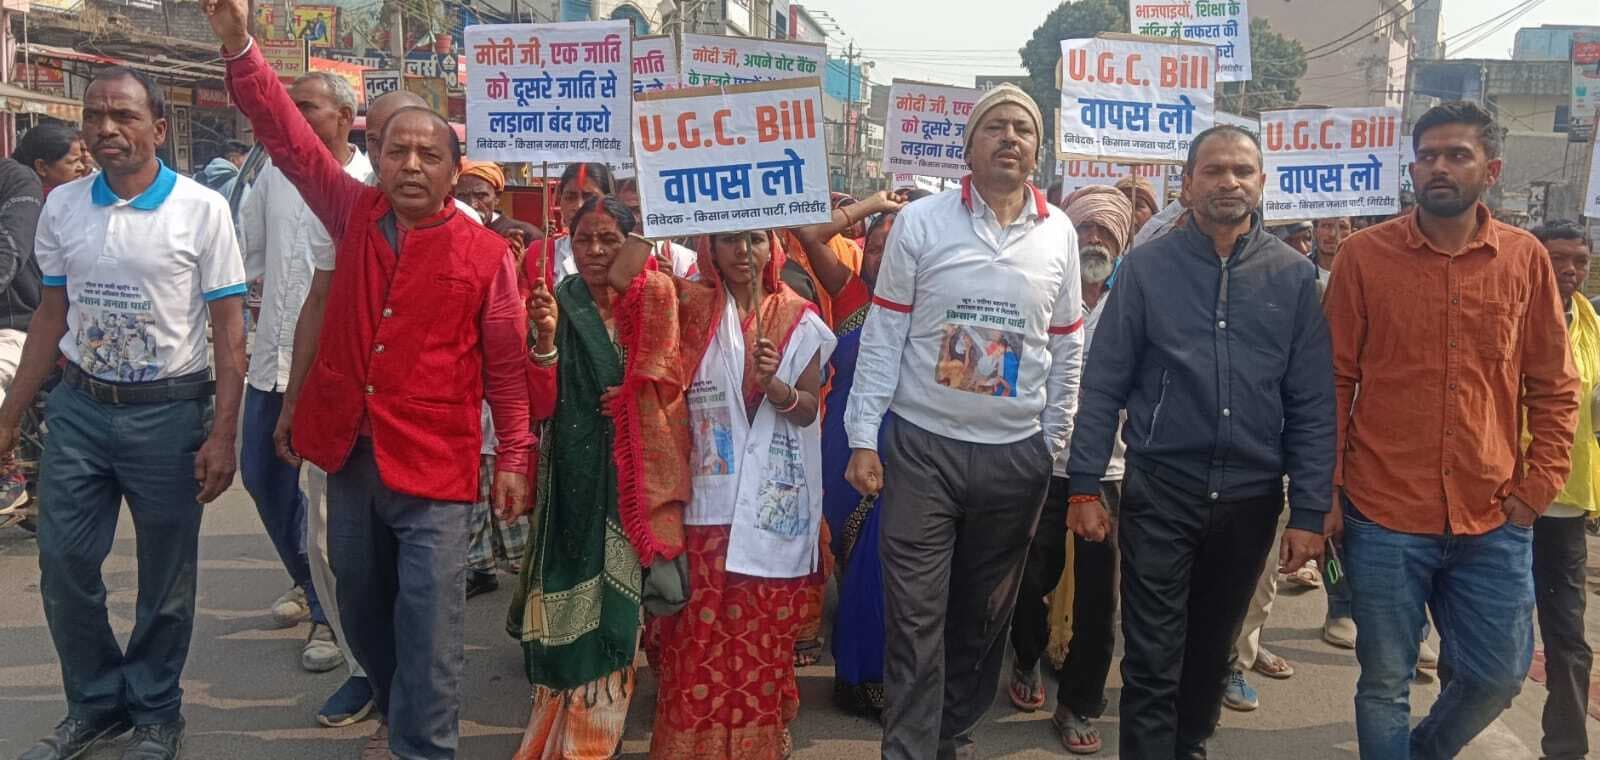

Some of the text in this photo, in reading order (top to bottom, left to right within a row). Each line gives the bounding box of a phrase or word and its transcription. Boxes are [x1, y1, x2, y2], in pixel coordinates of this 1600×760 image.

[1195, 1, 1225, 17] शिक्षा
[1226, 0, 1240, 16] के
[1169, 22, 1183, 38] में
[1183, 24, 1220, 39] नफरत
[1221, 19, 1238, 37] की
[473, 34, 622, 68] मोदी जी, एक जाति
[692, 46, 817, 73] मोदी जी, अपने वोट बैंक
[688, 69, 701, 86] के
[1069, 48, 1208, 88] U.G.C. Bill
[366, 77, 399, 93] नन्दन
[485, 71, 510, 99] को
[512, 70, 553, 106] दूसरे
[556, 69, 597, 98] जाति
[599, 69, 617, 98] से
[896, 93, 926, 112] मोदी
[928, 95, 948, 116] जी,
[1078, 95, 1196, 134] वापस लो
[488, 105, 611, 138] लड़ाना बंद करो
[639, 98, 816, 152] U.G.C. Bill
[901, 115, 919, 134] को
[921, 118, 952, 140] दूसरे
[1266, 115, 1395, 151] U.G.C. Bill
[477, 138, 506, 149] निवेदक
[515, 138, 543, 149] किसान
[545, 139, 569, 149] जनता
[570, 138, 590, 150] पार्टी,
[591, 138, 621, 150] गिरिडीह
[901, 141, 964, 159] लड़ाना बंद
[1064, 133, 1094, 145] निवेदक
[1102, 136, 1130, 147] किसान
[1132, 141, 1156, 149] जनता
[1157, 140, 1177, 151] पार्टी,
[659, 148, 805, 204] वापस लो
[1277, 164, 1344, 194] वापस
[1347, 153, 1383, 192] लो
[647, 214, 684, 226] निवेदक
[694, 210, 729, 222] किसान
[731, 207, 761, 219] जनता
[762, 203, 787, 217] पार्टी,
[789, 200, 826, 214] गिरिडीह
[1266, 201, 1292, 211] निवेदक
[1299, 199, 1325, 209] किसान
[1326, 199, 1348, 209] जनता
[1366, 197, 1395, 207] गिरिडीह
[946, 309, 977, 321] किसान
[979, 314, 1006, 325] जनता
